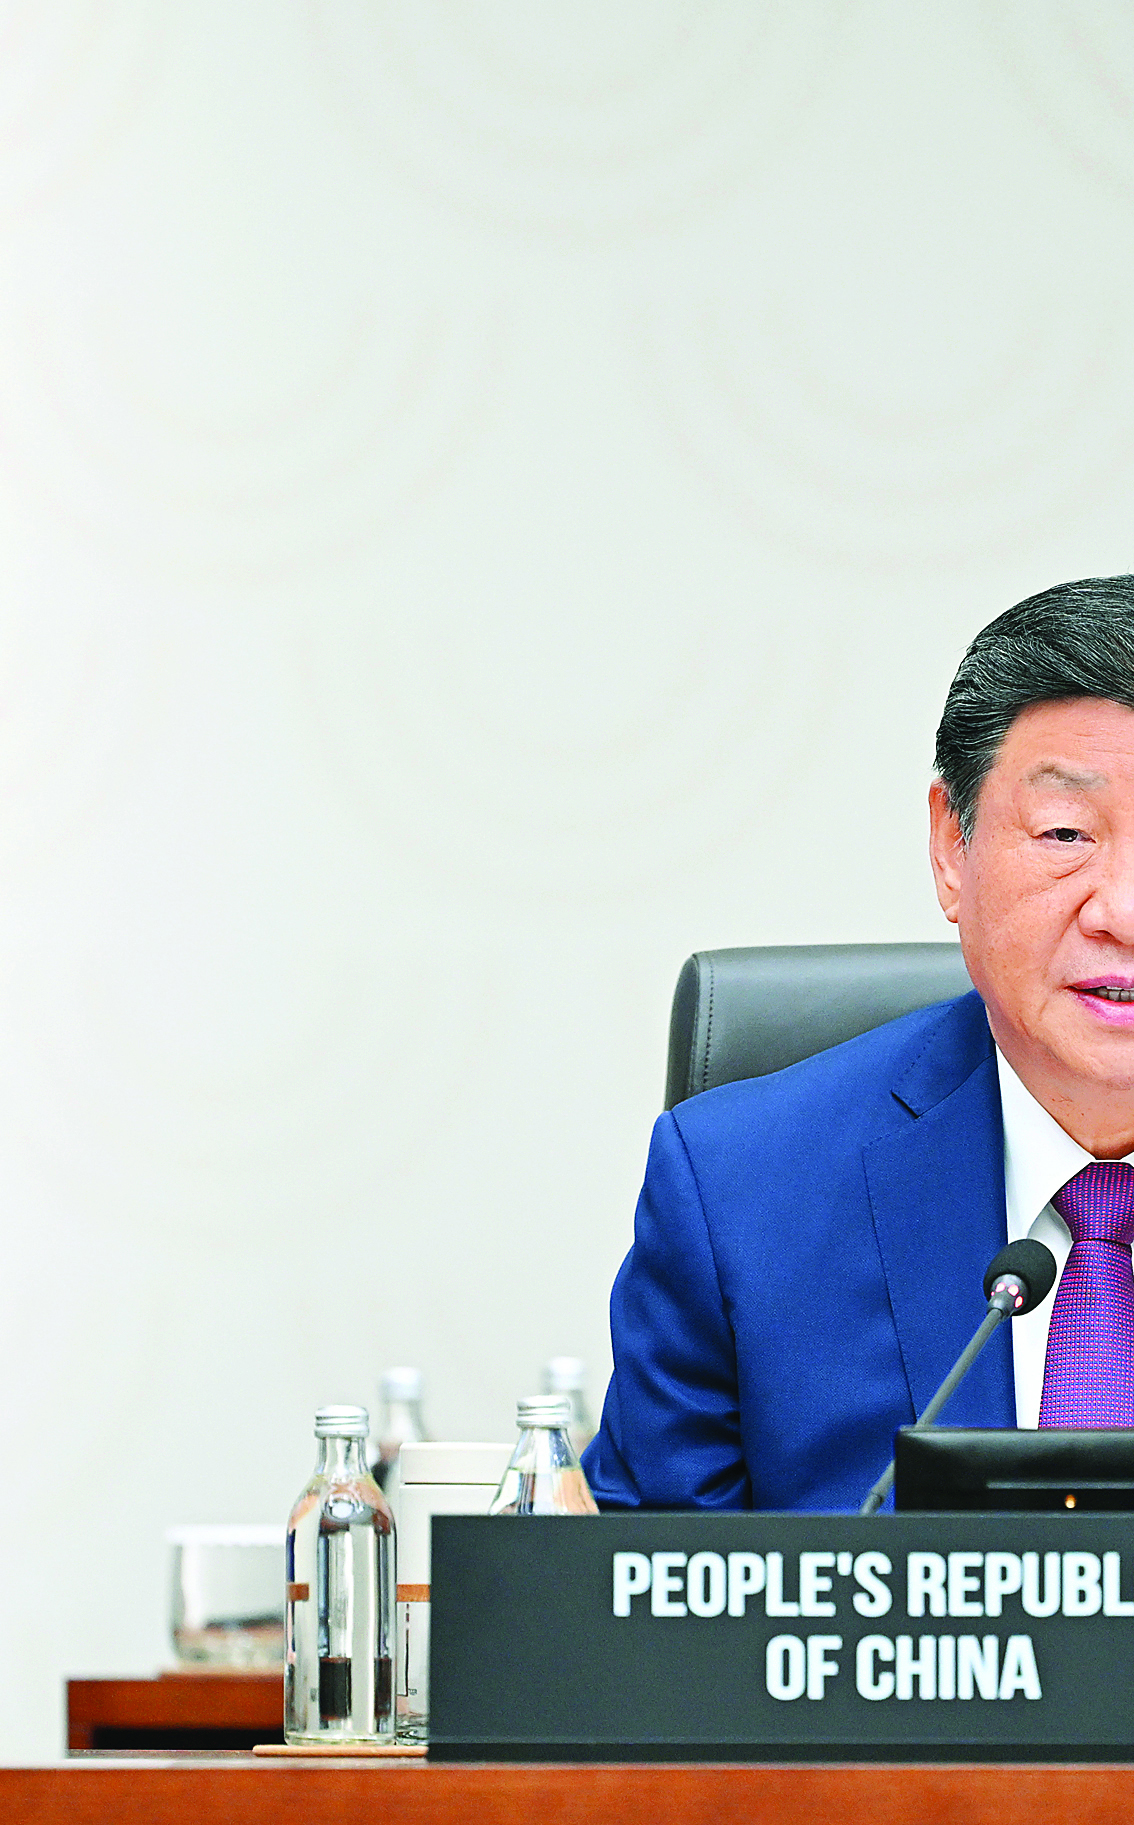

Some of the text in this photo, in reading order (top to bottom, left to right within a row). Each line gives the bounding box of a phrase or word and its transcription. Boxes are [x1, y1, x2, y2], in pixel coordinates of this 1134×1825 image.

[612, 1551, 893, 1617] PEOPLE'S
[765, 1634, 1042, 1700] OF CHINA
